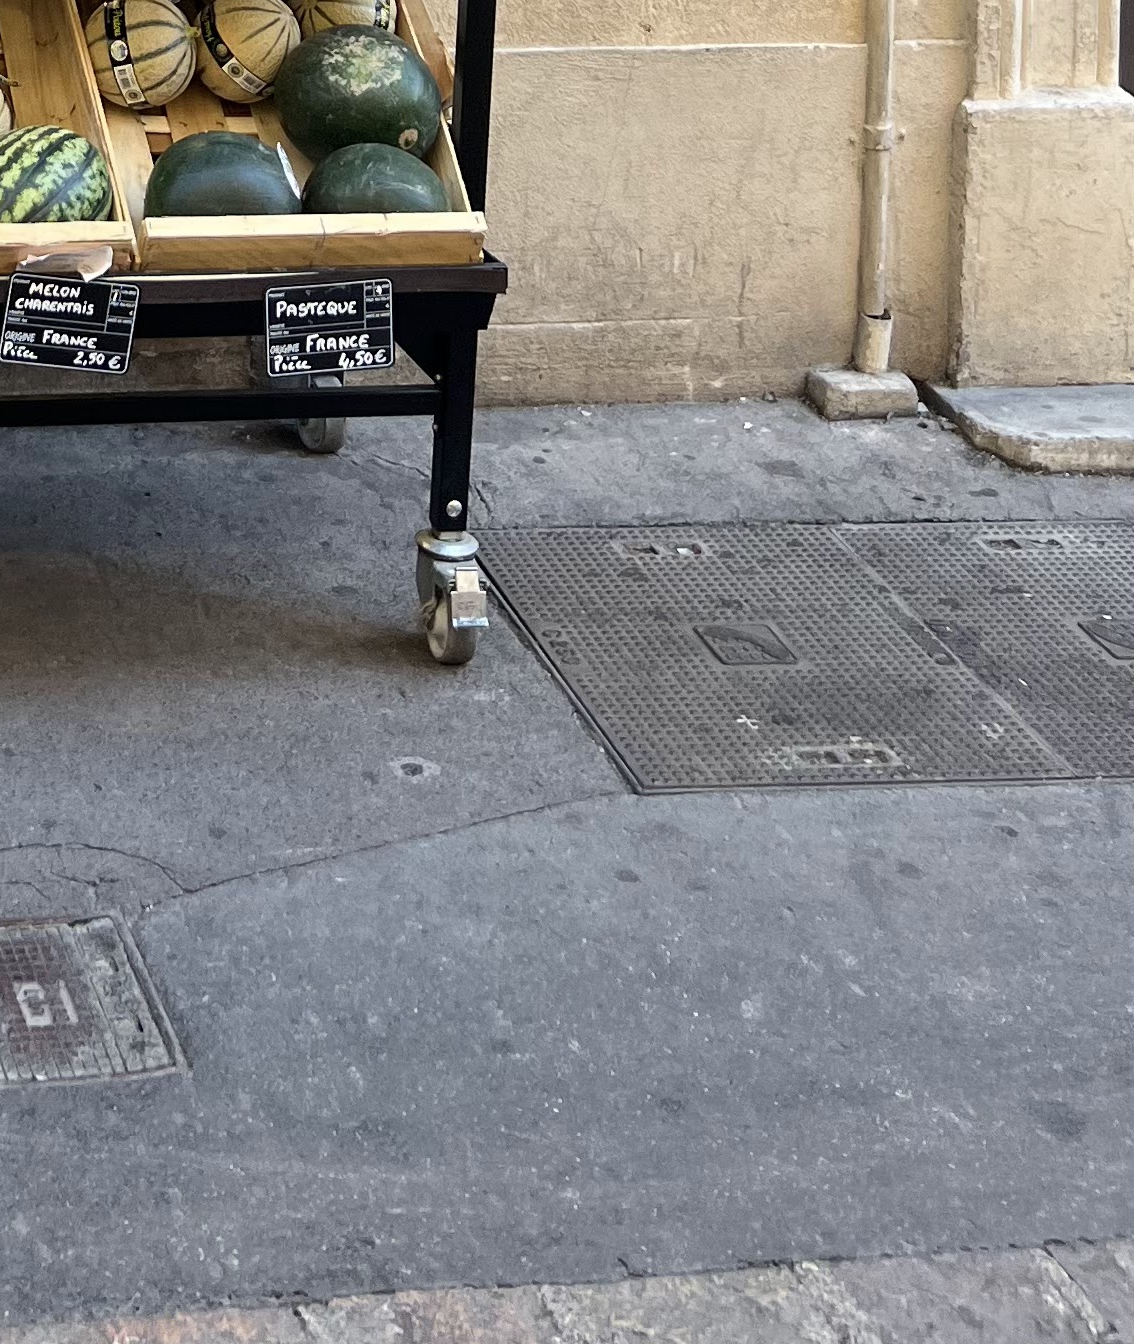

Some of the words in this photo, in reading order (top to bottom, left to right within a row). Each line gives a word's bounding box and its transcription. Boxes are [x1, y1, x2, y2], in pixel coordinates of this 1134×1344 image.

[29, 282, 81, 298] MELON
[15, 298, 95, 316] CHARENTAIS
[276, 300, 357, 318] PASTEQUE
[42, 330, 98, 349] FRANCE
[306, 333, 370, 352] FRANCE
